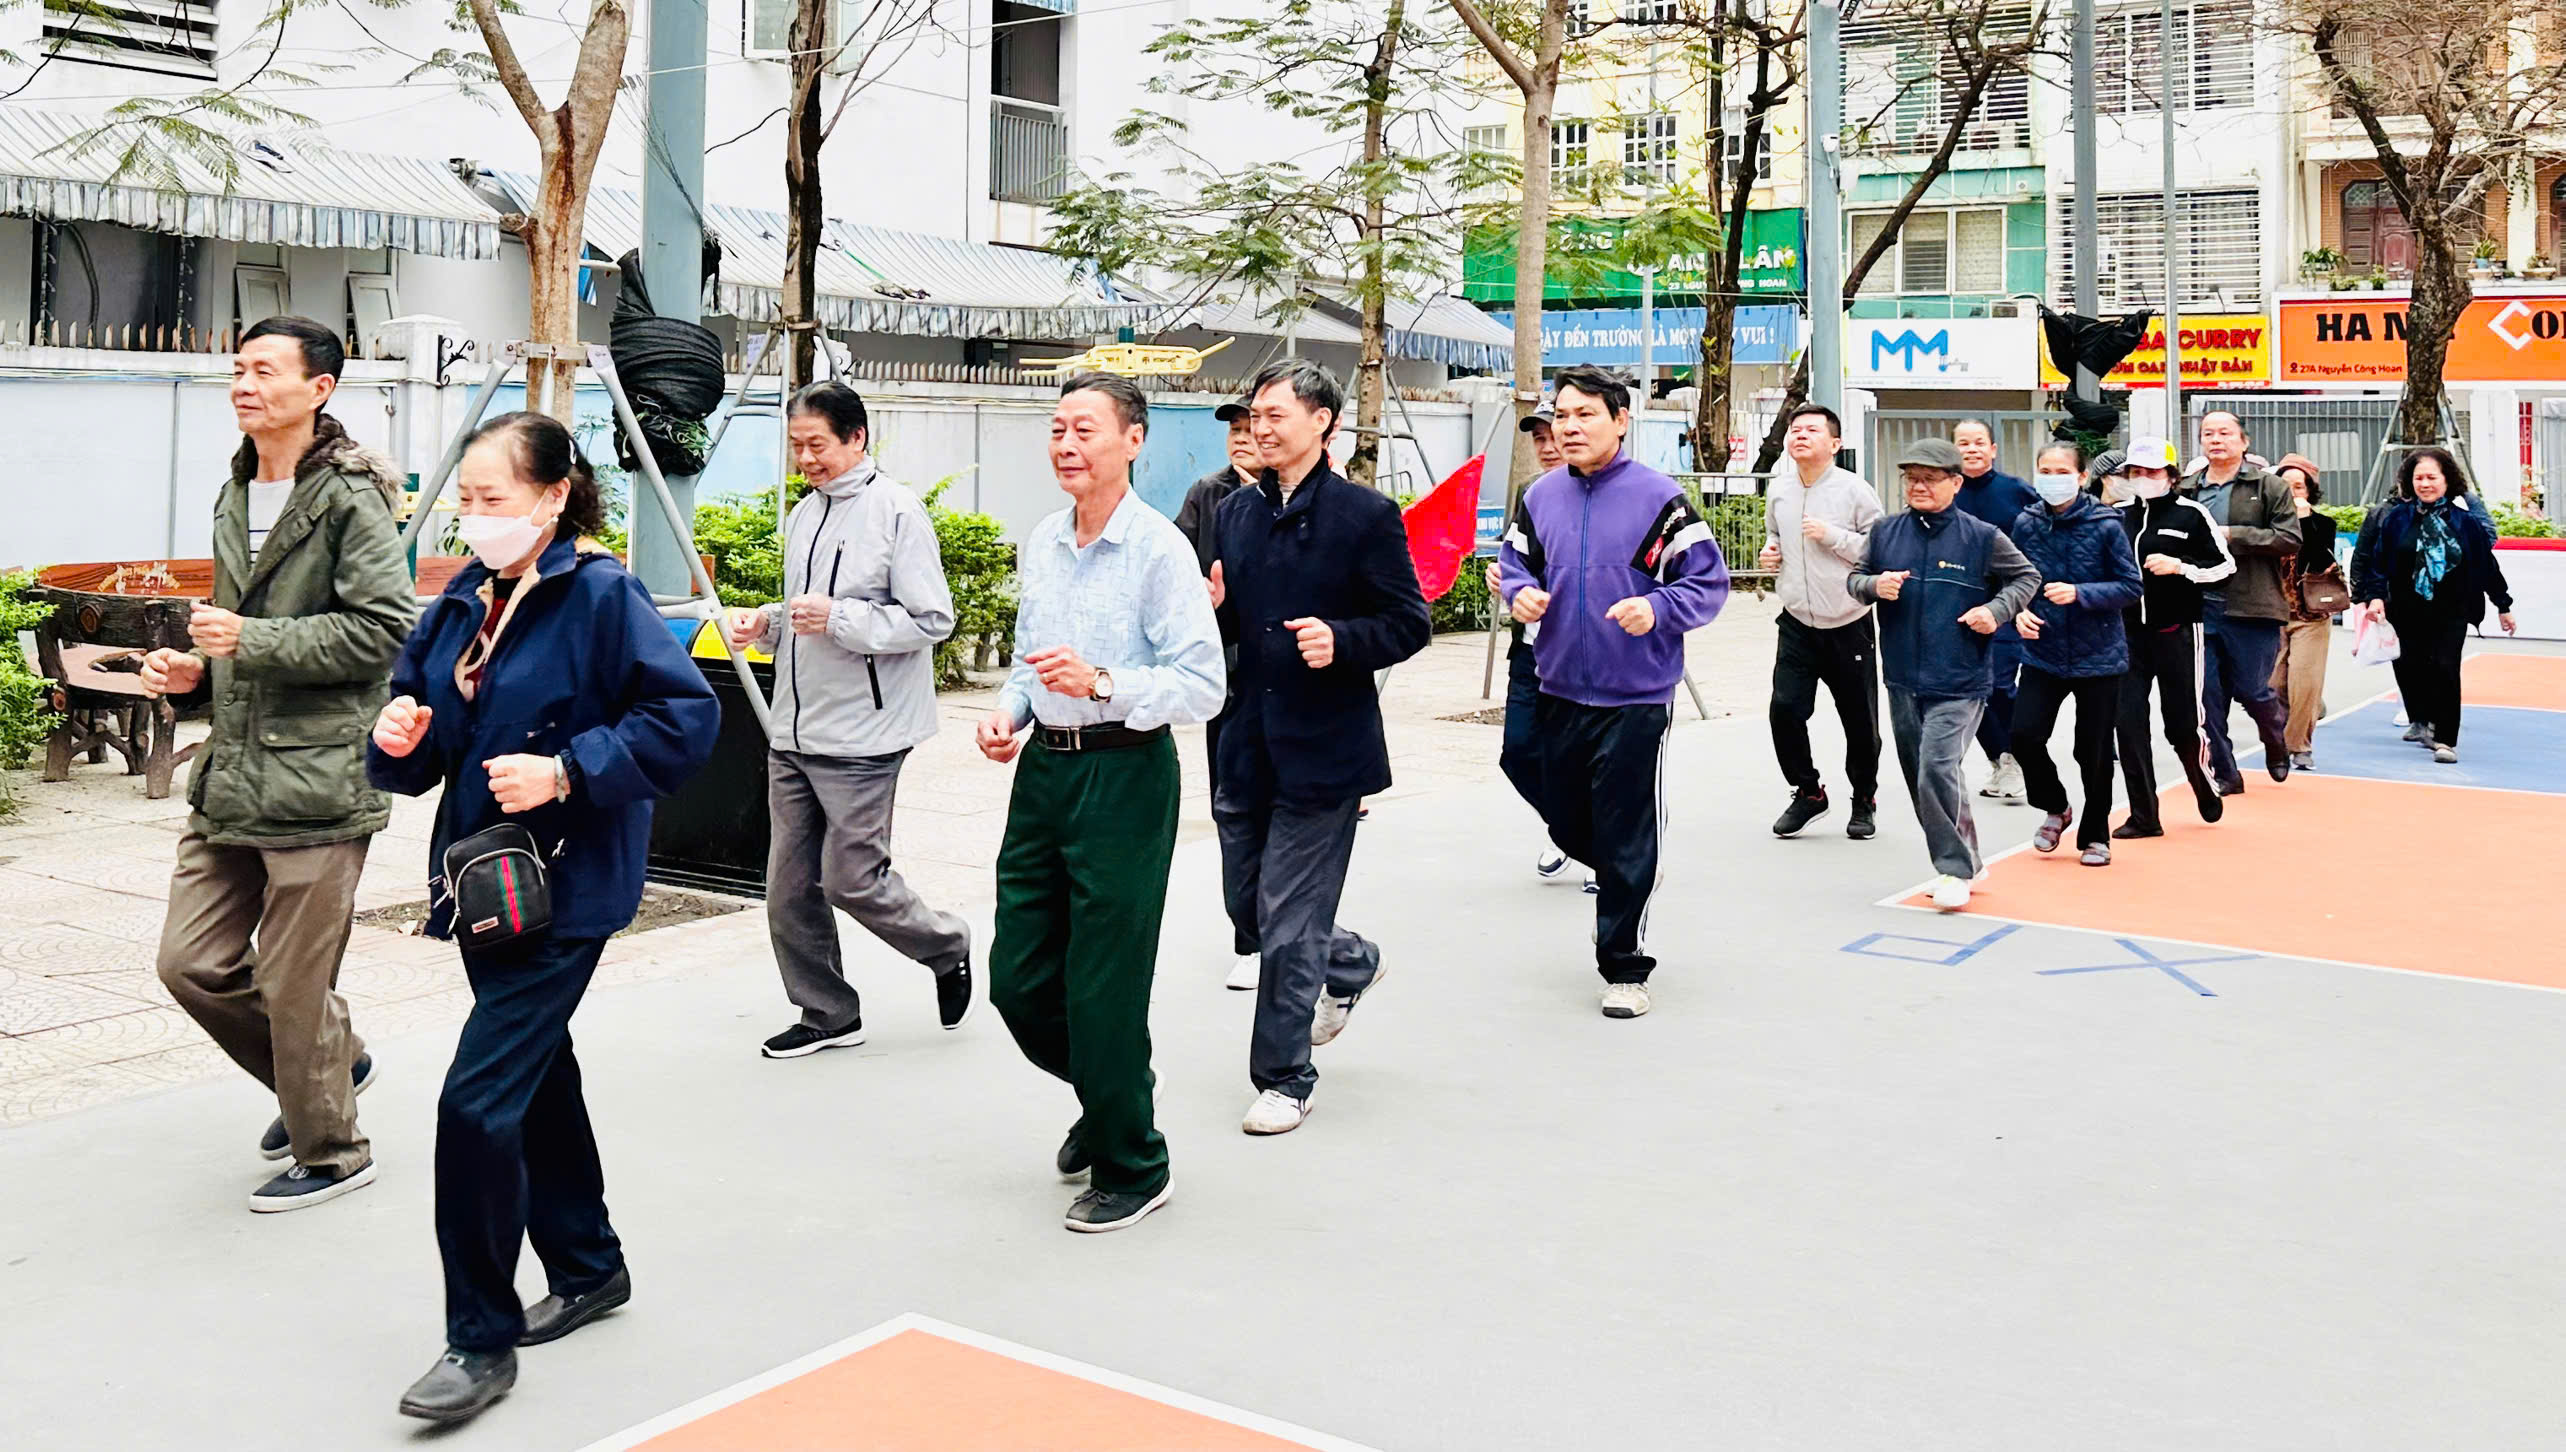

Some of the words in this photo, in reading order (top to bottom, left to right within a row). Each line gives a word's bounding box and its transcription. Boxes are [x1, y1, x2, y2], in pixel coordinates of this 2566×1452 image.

[1564, 323, 1589, 348] ĐẾN
[1651, 324, 1667, 346] LÀ
[1669, 324, 1697, 349] MỘT
[2317, 313, 2372, 341] HA
[2178, 328, 2262, 350] CURRY
[2179, 357, 2218, 376] NHẬT
[2221, 357, 2253, 373] BẢN
[2378, 364, 2402, 374] Hoan
